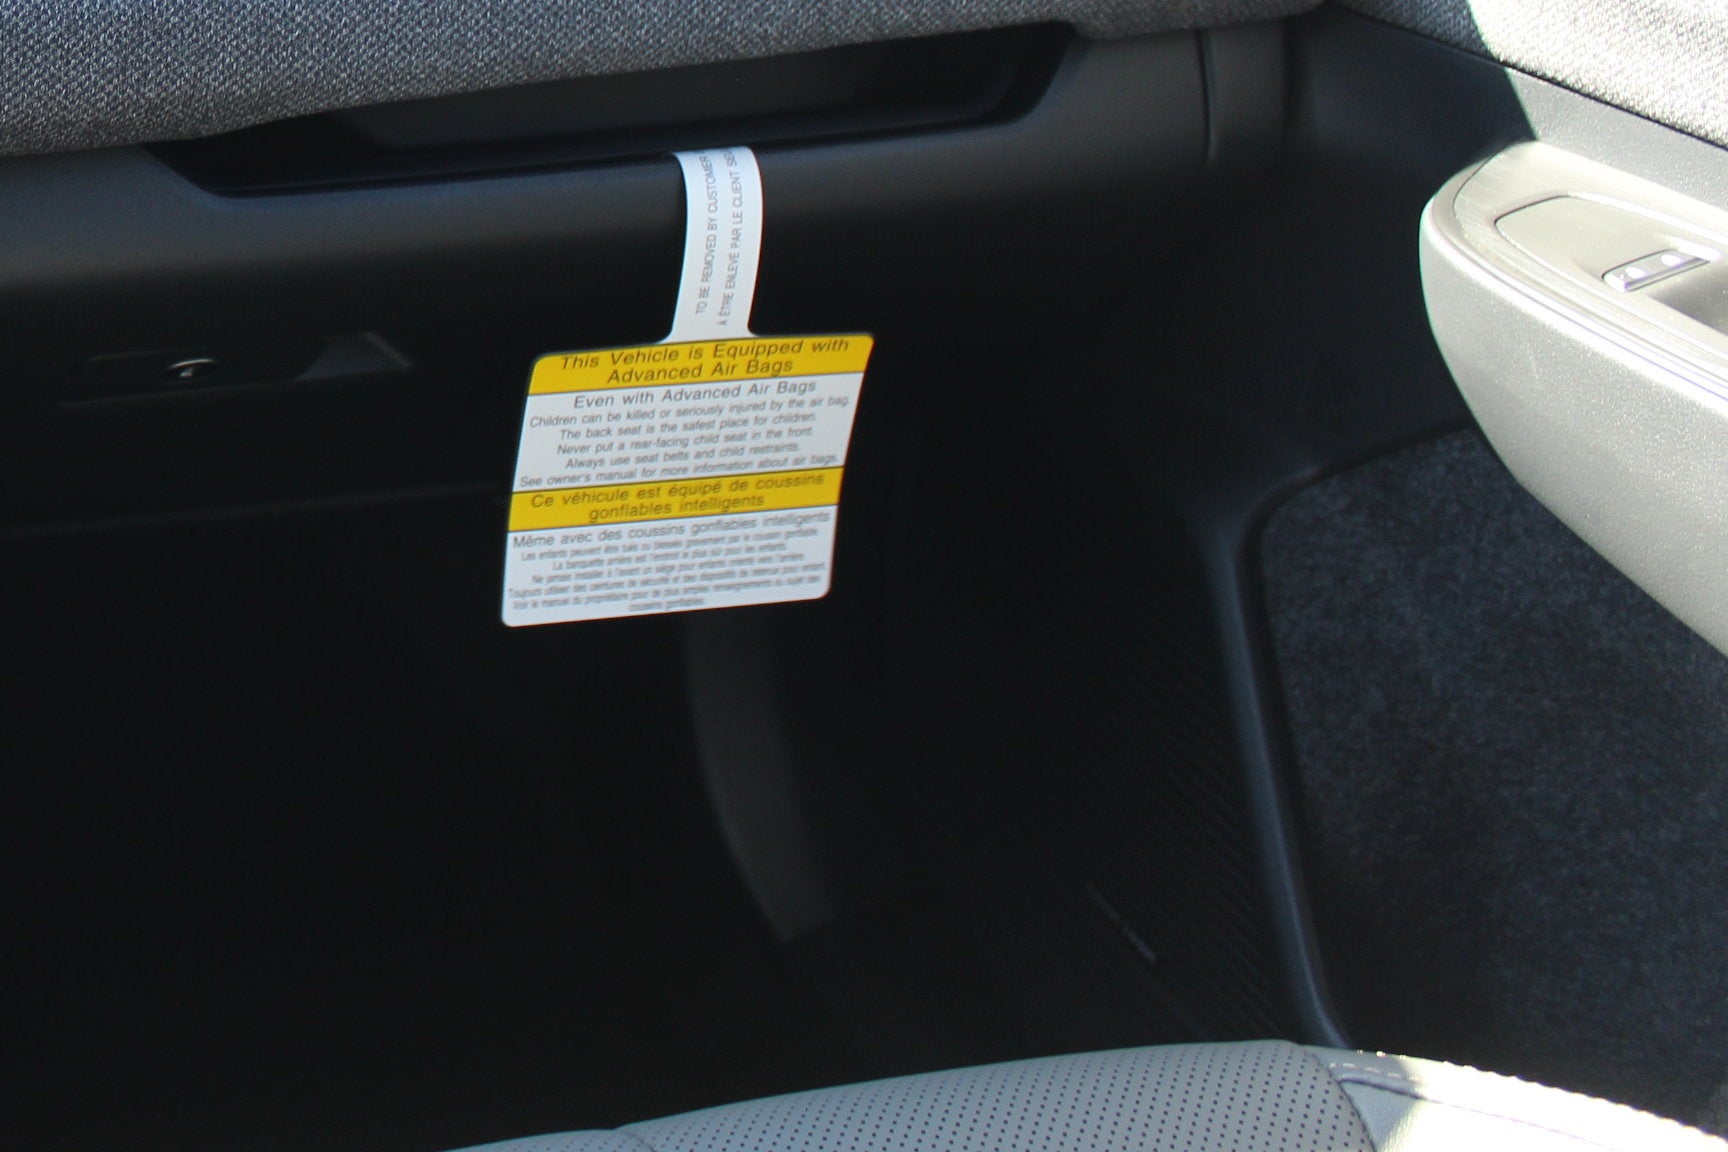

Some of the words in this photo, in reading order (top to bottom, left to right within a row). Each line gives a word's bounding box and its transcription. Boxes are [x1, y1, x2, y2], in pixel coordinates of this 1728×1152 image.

[699, 155, 718, 213] CUSTOMER
[729, 170, 743, 208] CLIENT
[707, 218, 718, 231] BY
[732, 211, 743, 225] LE
[731, 227, 742, 249] PAR
[701, 234, 717, 283] REMOVED
[699, 286, 710, 299] BE
[695, 301, 707, 315] TO
[561, 355, 599, 370] This
[611, 348, 679, 366] Vehicle
[688, 347, 703, 360] is
[713, 340, 804, 359] Equipped
[812, 338, 850, 352] with
[607, 364, 703, 384] Advanced
[710, 361, 738, 377] Air
[746, 359, 794, 376] Bags
[573, 395, 614, 409] Even
[622, 392, 654, 405] with
[661, 385, 741, 402] Advanced
[747, 382, 771, 396] Air
[777, 380, 817, 395] Bags
[530, 416, 577, 428] Children
[581, 414, 602, 424] can
[607, 411, 621, 423] be
[626, 409, 655, 421] killed
[659, 409, 671, 419] or
[675, 404, 725, 417] seriously
[728, 400, 766, 415] injured
[770, 398, 783, 412] by
[788, 397, 805, 408] the
[560, 429, 581, 440] The
[586, 427, 612, 438] back
[617, 425, 641, 436] seat
[646, 423, 655, 434] is
[660, 422, 677, 433] the
[682, 419, 716, 432] safest
[720, 416, 749, 430] place
[754, 415, 768, 426] for
[557, 444, 591, 456] Never
[595, 442, 614, 454] put
[617, 442, 625, 451] a
[630, 437, 689, 450] rear-facing
[693, 433, 720, 445] child
[724, 431, 747, 442] seat
[752, 430, 762, 440] in
[565, 457, 606, 470] Always
[610, 456, 630, 466] use
[635, 453, 659, 464] seat
[663, 450, 689, 461] belts
[520, 476, 543, 487] See
[547, 472, 591, 485] owner's
[596, 469, 637, 481] manual
[641, 467, 657, 478] for
[660, 465, 689, 476] more
[693, 460, 753, 473] information
[531, 494, 554, 508] Ce
[562, 489, 629, 505] véhicule
[636, 486, 661, 499] est
[668, 481, 722, 497] équipé
[728, 478, 749, 492] de
[755, 474, 825, 490] coussins
[588, 503, 672, 524] gonflables
[679, 495, 765, 513] intelligents
[513, 535, 555, 548] Même
[560, 532, 593, 544] avec
[598, 529, 622, 542] des
[628, 524, 686, 539] coussins
